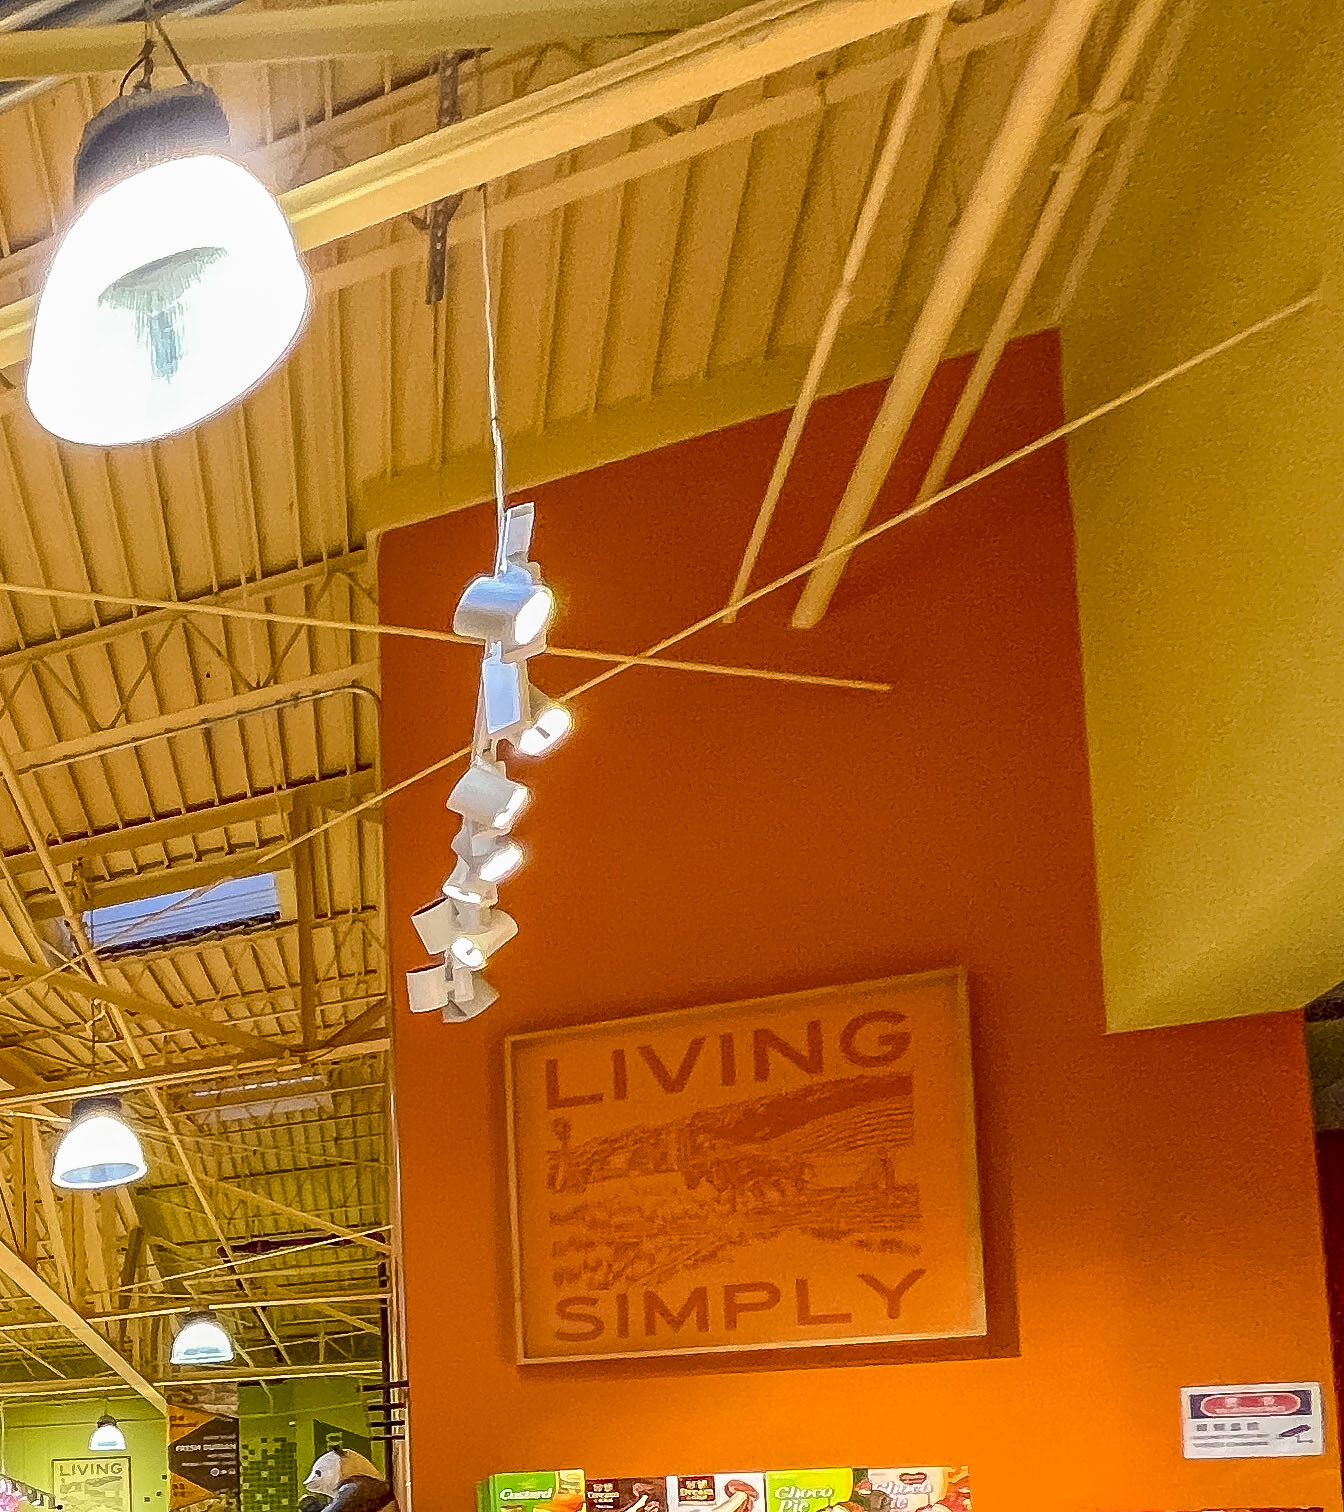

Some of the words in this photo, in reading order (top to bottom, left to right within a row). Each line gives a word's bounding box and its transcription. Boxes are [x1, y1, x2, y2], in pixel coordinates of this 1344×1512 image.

[544, 1010, 911, 1110] LIVING
[555, 1269, 926, 1342] SIMPLY
[60, 1463, 123, 1476] LIVING
[774, 1486, 833, 1500] Choco
